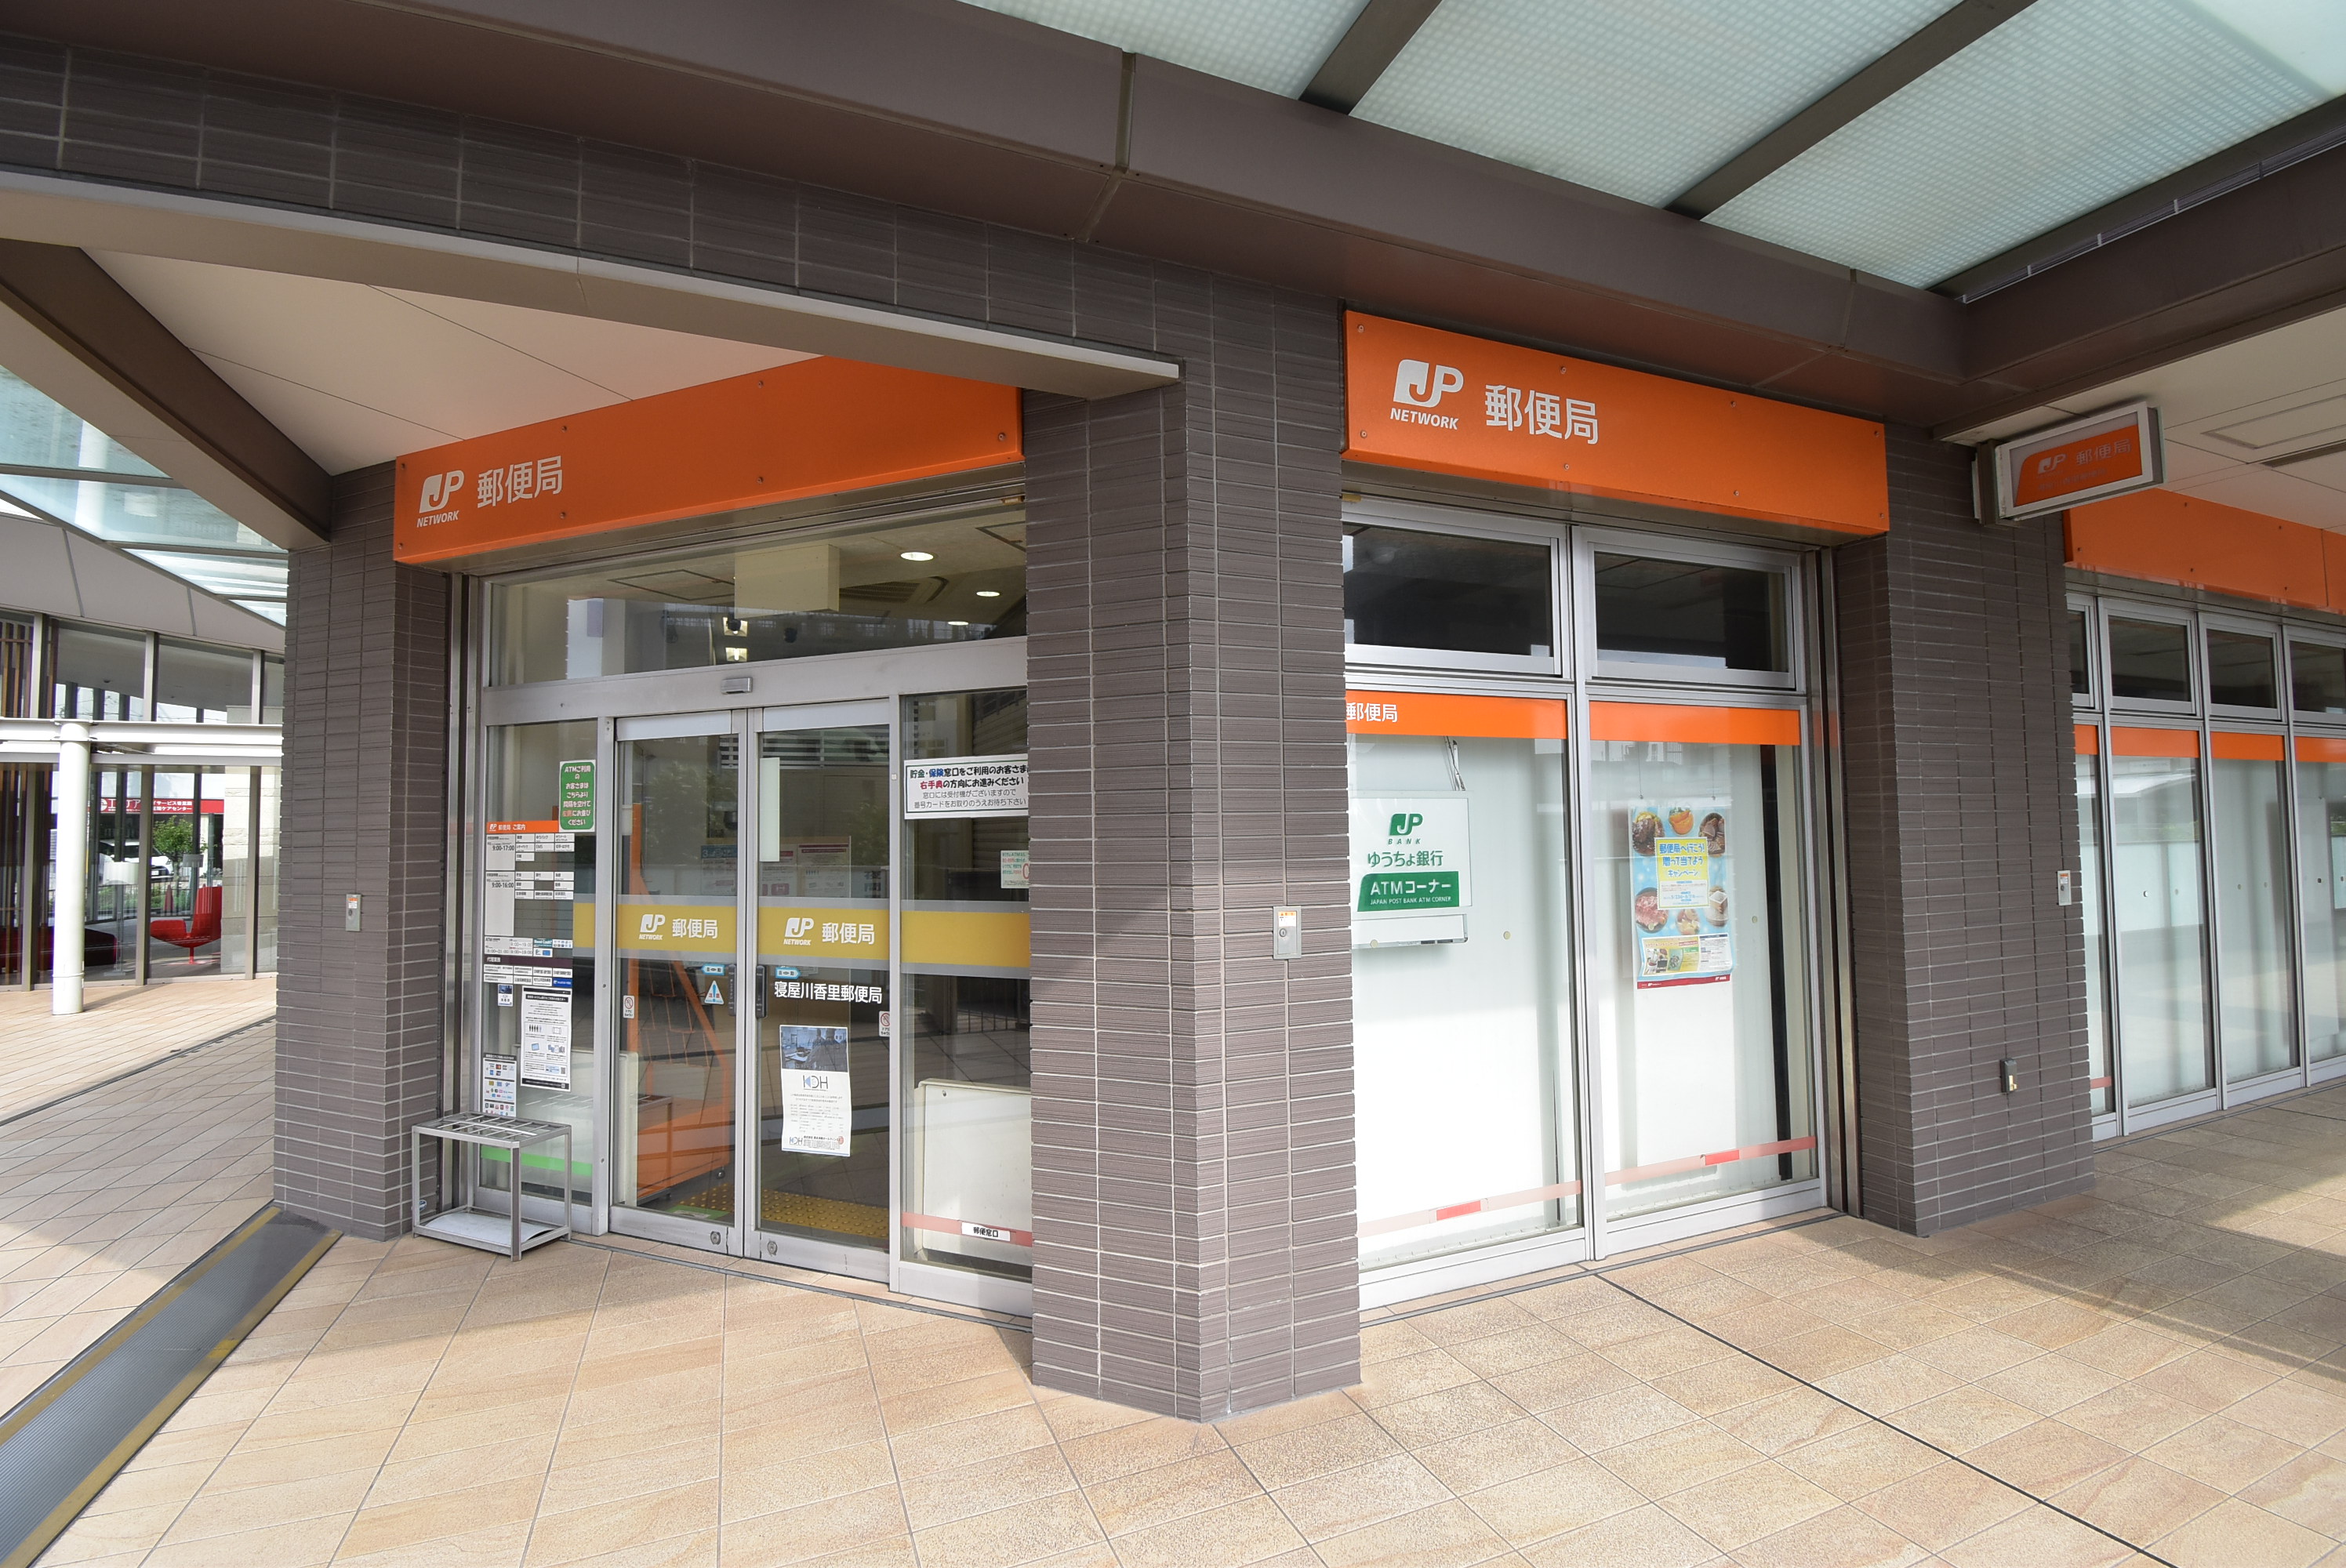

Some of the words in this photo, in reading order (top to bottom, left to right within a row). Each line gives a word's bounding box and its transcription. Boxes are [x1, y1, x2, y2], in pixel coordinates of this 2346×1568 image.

[1393, 359, 1464, 408] JP
[1390, 408, 1459, 430] NETWORK
[1486, 384, 1599, 445] 郵便局
[2076, 438, 2131, 466] 郵便局
[419, 470, 464, 514] JP
[477, 456, 563, 509] 郵便局
[416, 510, 459, 528] NETWORK
[1346, 702, 1397, 722] 郵便局
[922, 789, 1016, 799] 窓口には受付機がございますので
[1389, 813, 1423, 836] JP
[1367, 850, 1444, 867] ゆうちょ銀行
[1370, 878, 1451, 895] ATMコーナー
[639, 913, 666, 933] JP
[672, 918, 718, 938] 郵便局
[784, 917, 814, 938] JP
[822, 922, 875, 945] 郵便局
[774, 981, 883, 1004] 寝屋川香里郵便局
[973, 1226, 999, 1237] 郵便窓口
